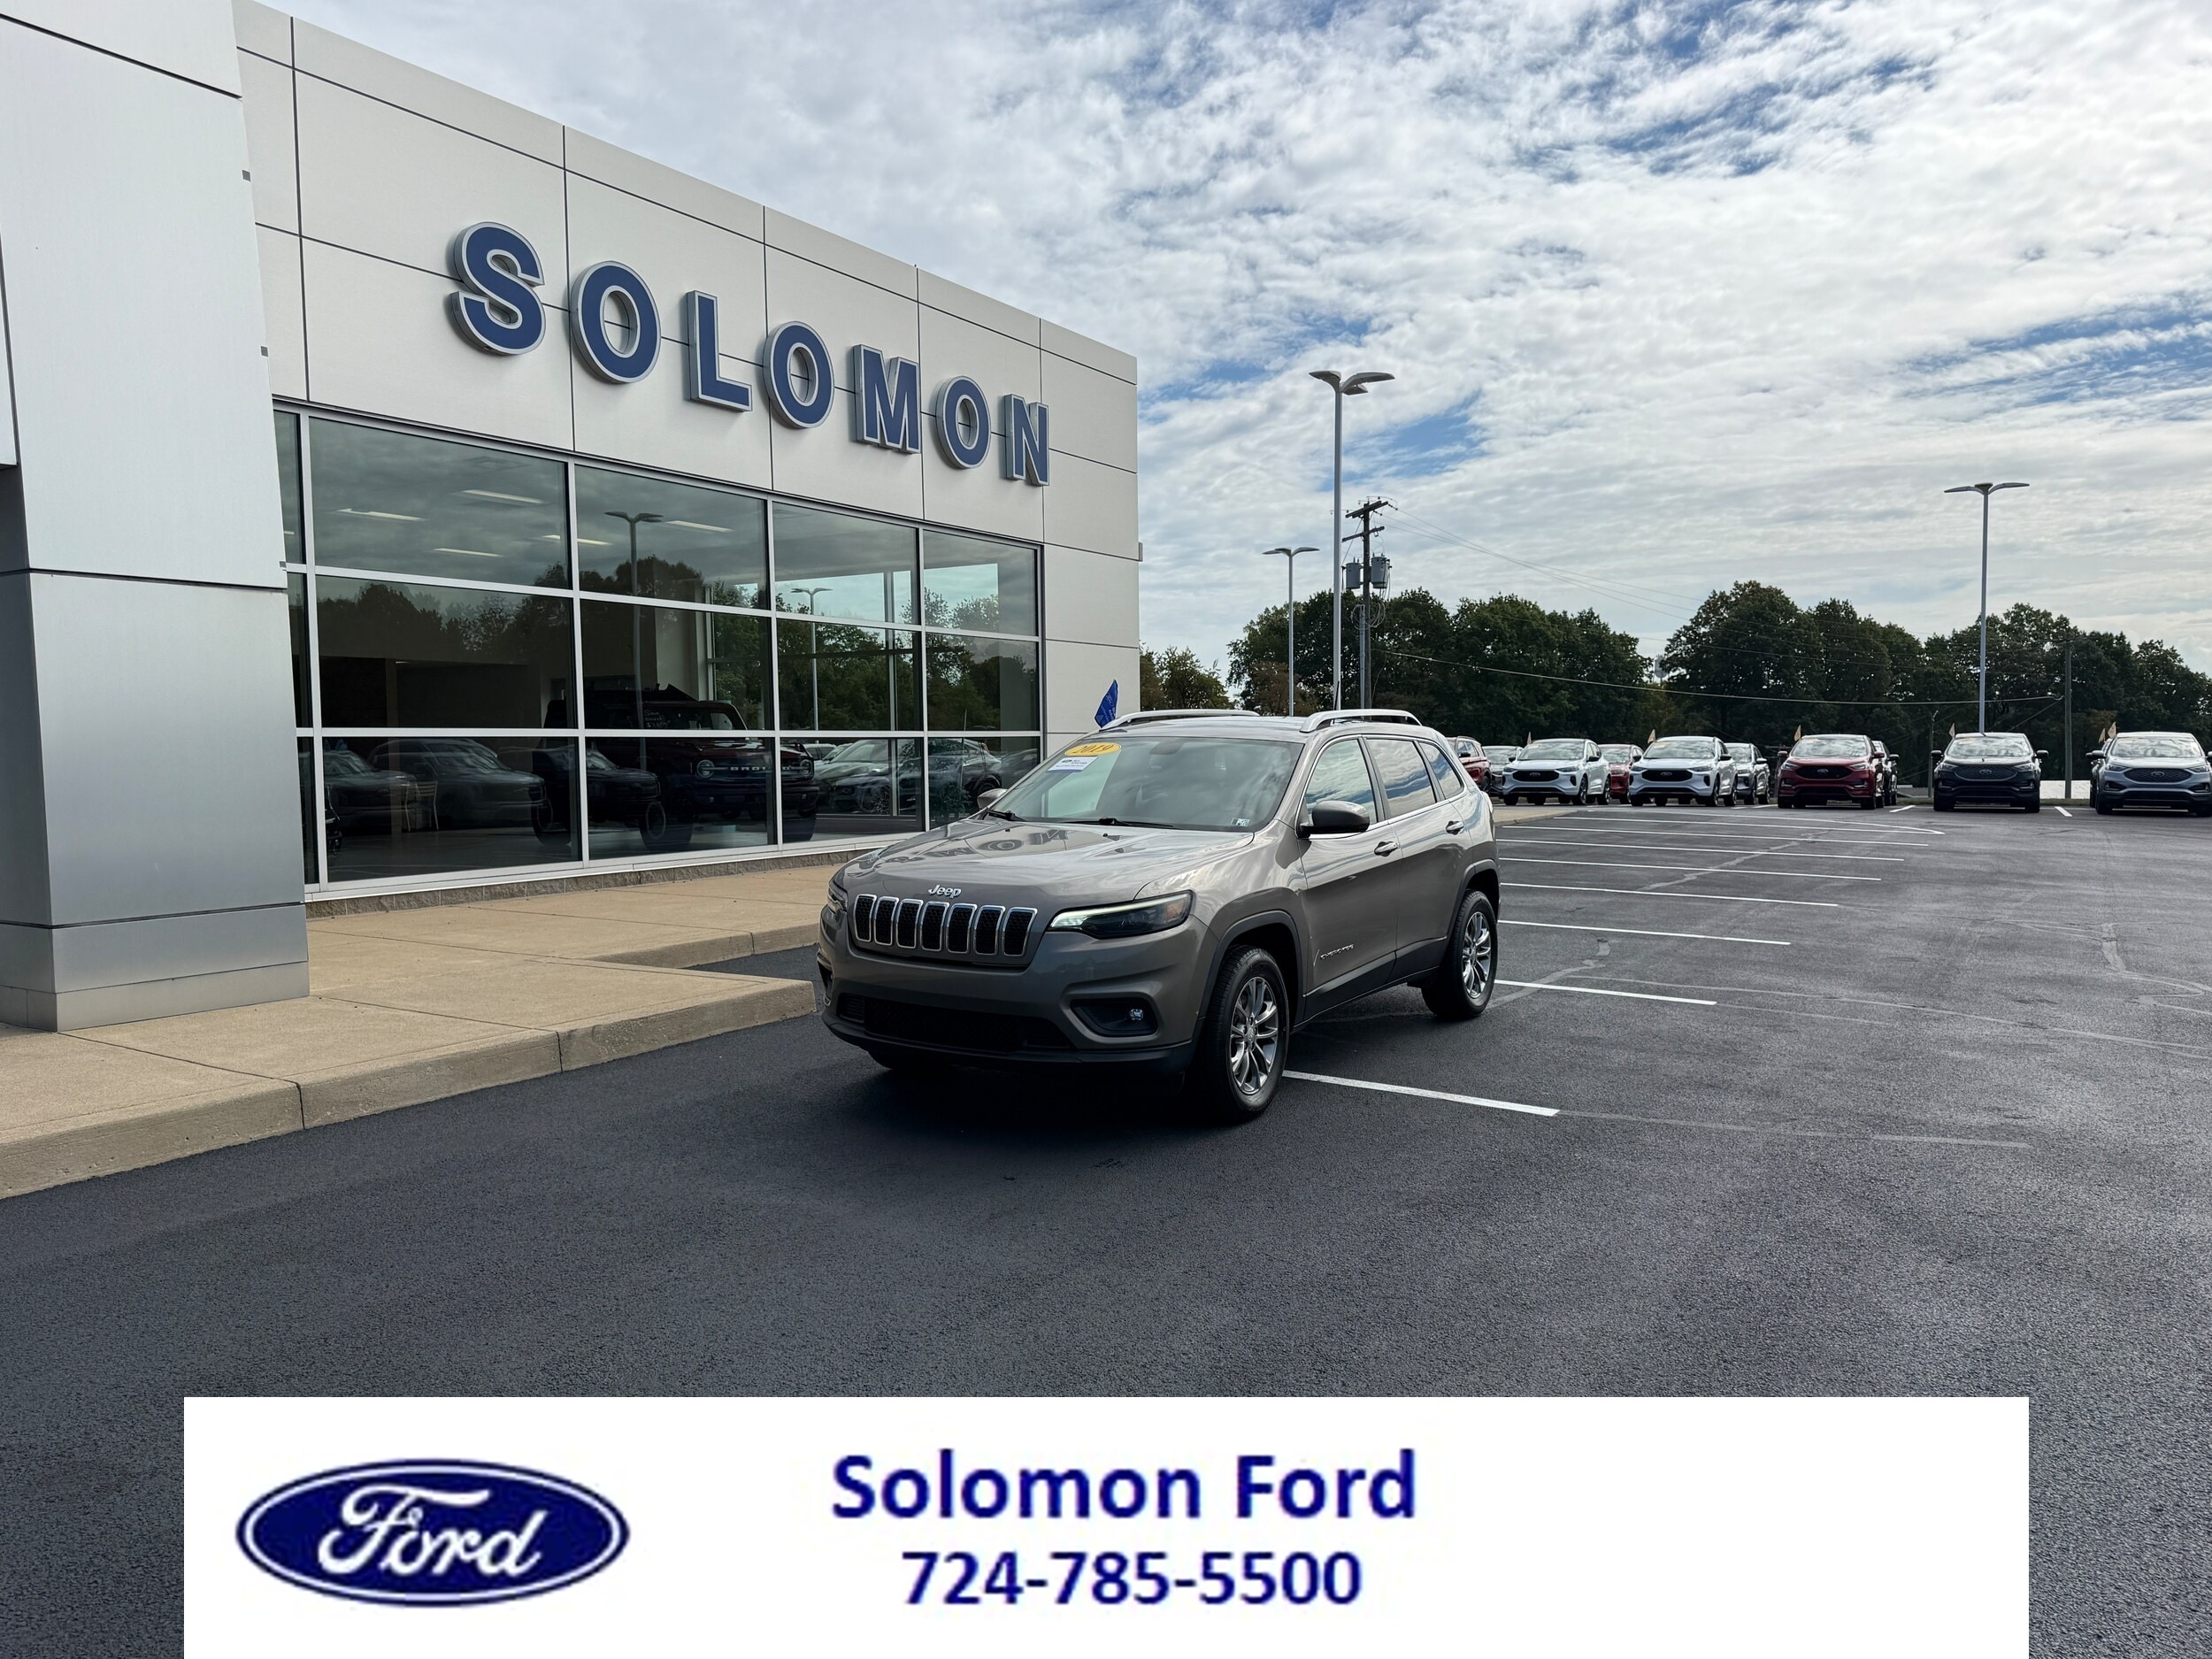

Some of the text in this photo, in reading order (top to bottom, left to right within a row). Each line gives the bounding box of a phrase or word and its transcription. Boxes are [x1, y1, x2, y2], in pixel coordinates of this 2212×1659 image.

[449, 221, 1051, 487] SOLOMON
[1071, 744, 1115, 754] 2019
[927, 884, 962, 899] Jeep
